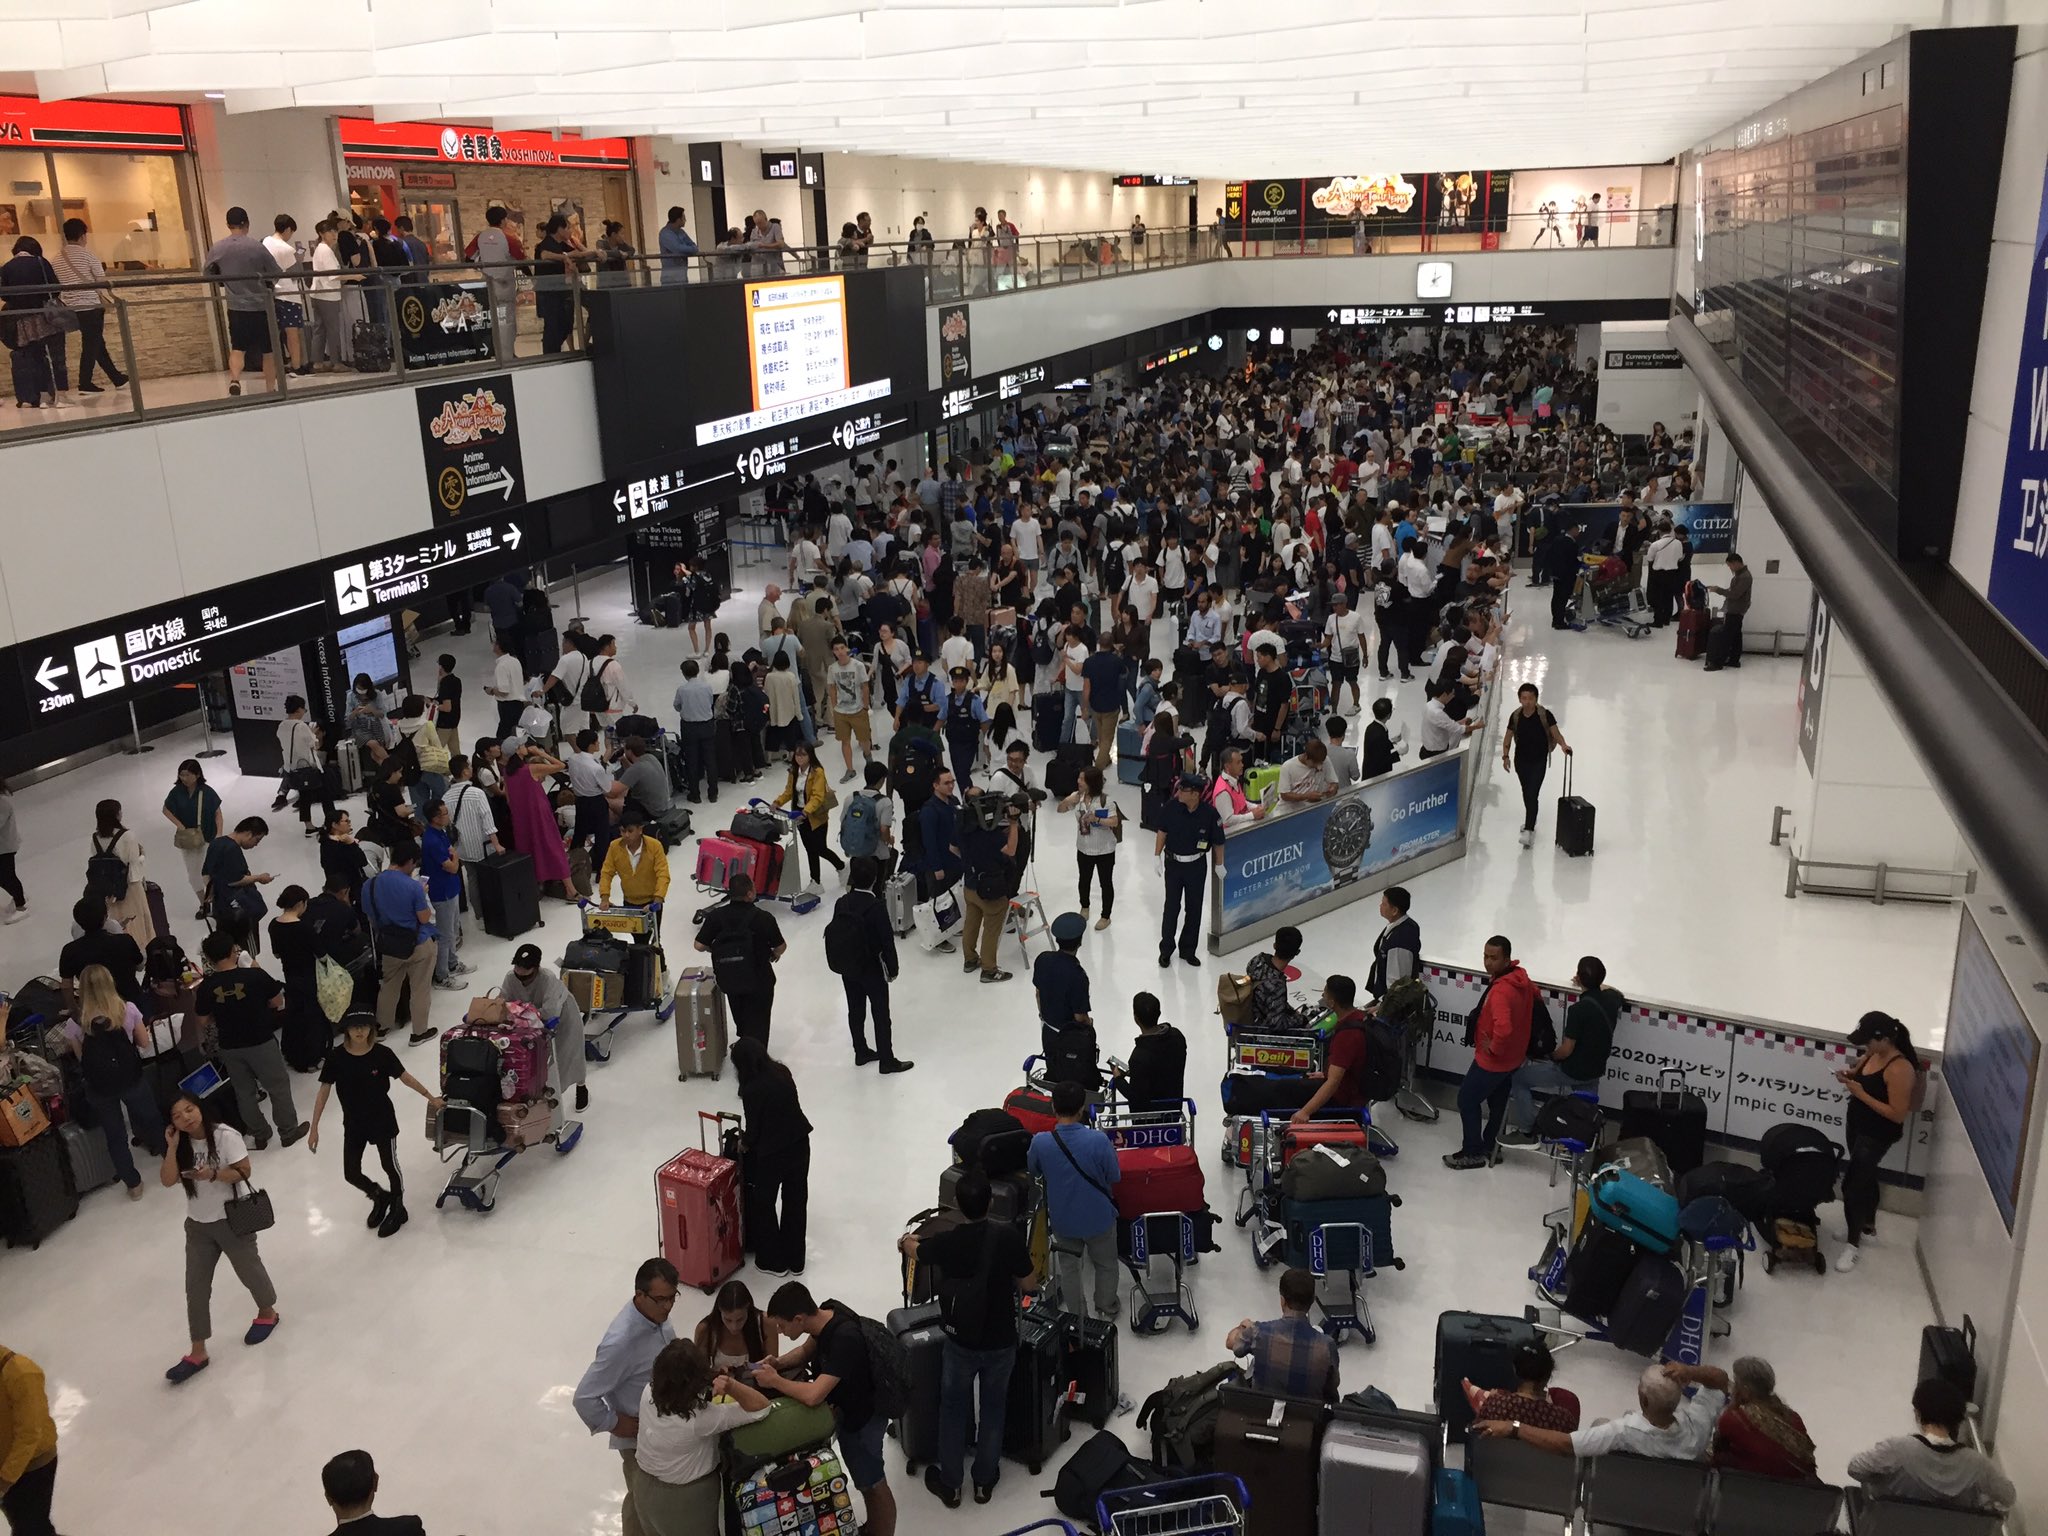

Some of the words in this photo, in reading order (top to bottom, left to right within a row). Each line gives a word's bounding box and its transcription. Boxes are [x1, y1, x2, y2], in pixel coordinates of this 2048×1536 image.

[461, 134, 503, 161] 吉野家
[503, 147, 556, 162] YOSHINOYA
[345, 165, 396, 180] OSHINOYA
[1251, 209, 1271, 217] Anime
[1272, 208, 1298, 216] Tourism
[1251, 216, 1286, 224] Information
[1357, 308, 1403, 317] 第3ターミナル
[1357, 317, 1381, 325] Terminal
[1492, 315, 1511, 323] Toilets
[410, 354, 426, 363] Anime
[426, 352, 447, 361] Tourism
[447, 347, 477, 358] Information
[1625, 353, 1652, 361] Currency
[855, 415, 872, 432] ご案内
[855, 431, 880, 446] Information
[463, 452, 484, 464] Anime
[765, 440, 785, 461] 駐車場
[464, 462, 490, 475] Tourism
[465, 470, 501, 487] Information
[766, 461, 786, 476] Parking
[648, 475, 670, 495] 鉄道
[651, 498, 669, 512] Train
[661, 526, 682, 534] Tickets
[368, 539, 457, 582] 第3ターミナル
[373, 575, 421, 604] Terminal
[421, 574, 430, 590] 3
[201, 606, 219, 620] 国内
[203, 615, 228, 632] 국내선
[124, 616, 187, 656] 国内線
[317, 636, 328, 665] Access
[130, 647, 202, 684] Domestic
[39, 693, 75, 714] 230m
[321, 666, 337, 724] Information
[1390, 807, 1406, 823] Go
[1408, 792, 1449, 817] Further
[1399, 829, 1441, 852] PROMASTER
[1241, 841, 1305, 879] CITIZEN
[1233, 883, 1262, 898] BETTER
[1264, 871, 1293, 887] STARTS
[1294, 863, 1312, 876] NOW
[601, 920, 628, 928] FANUC
[1607, 1067, 1630, 1081] pic
[1634, 1073, 1665, 1089] and
[1670, 1078, 1721, 1103] Paraly
[1783, 1102, 1843, 1127] Games
[1132, 1128, 1178, 1145] DHC
[1135, 1225, 1145, 1260] DHC
[1183, 1222, 1191, 1257] DHC
[1313, 1235, 1323, 1270] DHC
[1362, 1234, 1370, 1268] DHC
[1545, 1257, 1562, 1288] DHC
[1678, 1315, 1702, 1365] DHC
